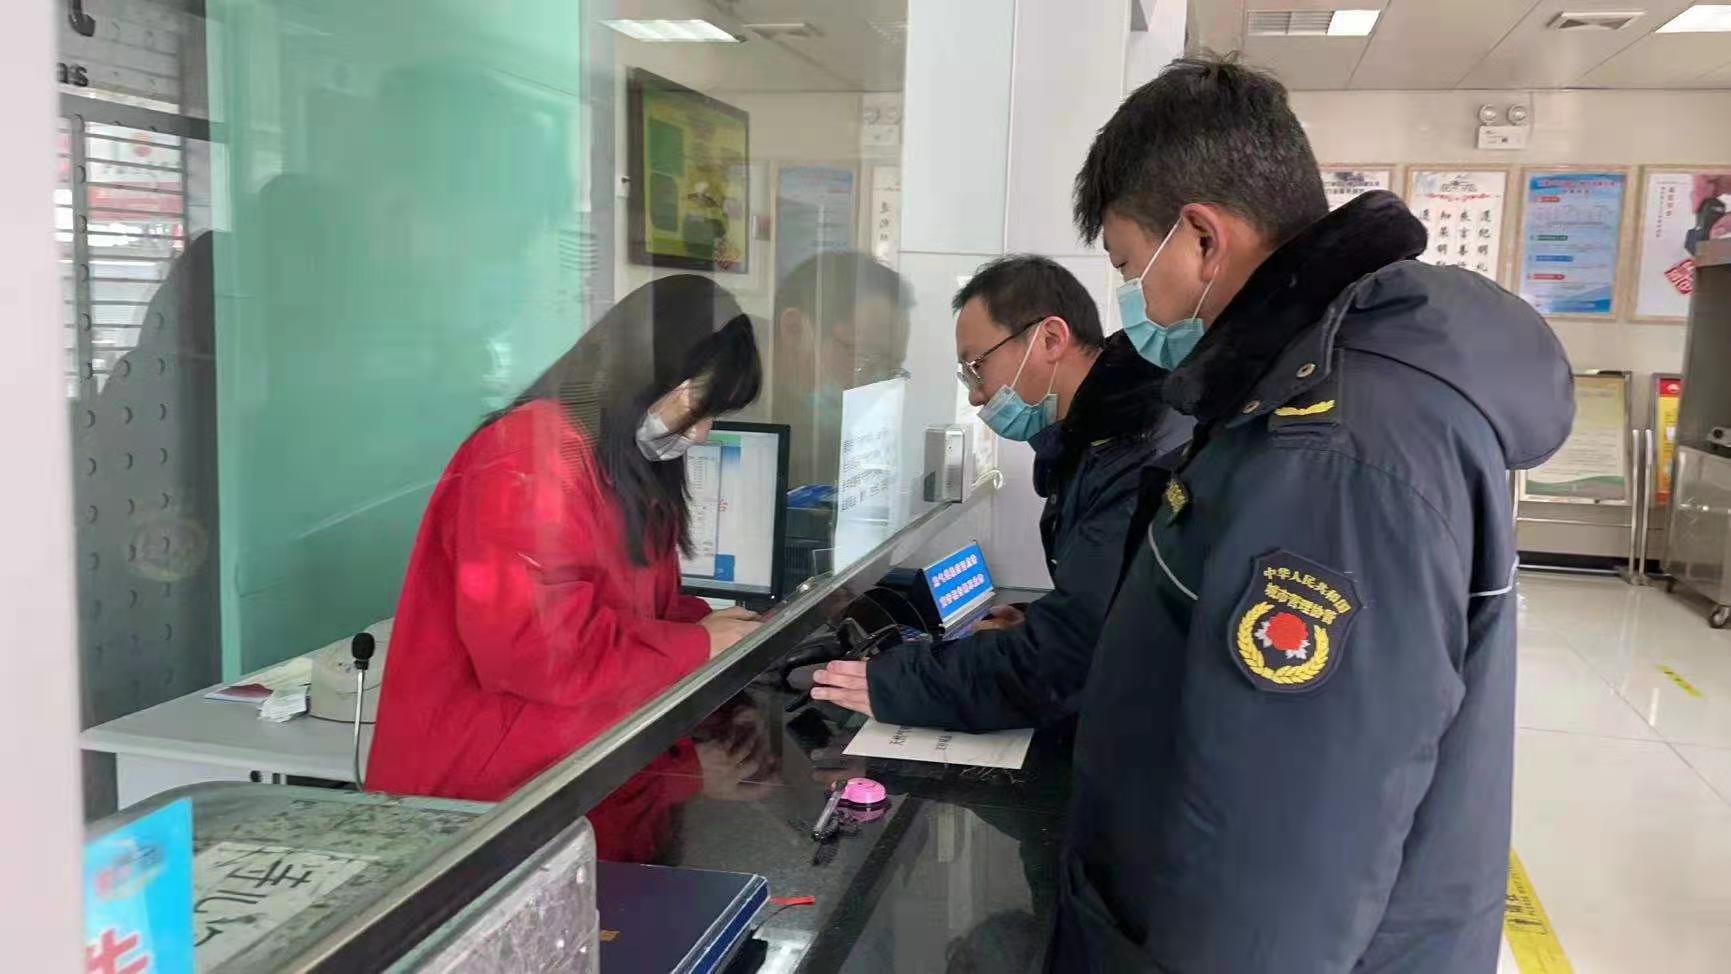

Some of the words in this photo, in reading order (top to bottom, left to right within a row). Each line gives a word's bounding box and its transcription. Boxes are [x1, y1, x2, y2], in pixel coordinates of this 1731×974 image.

[1263, 566, 1352, 614] 中华人民共和国
